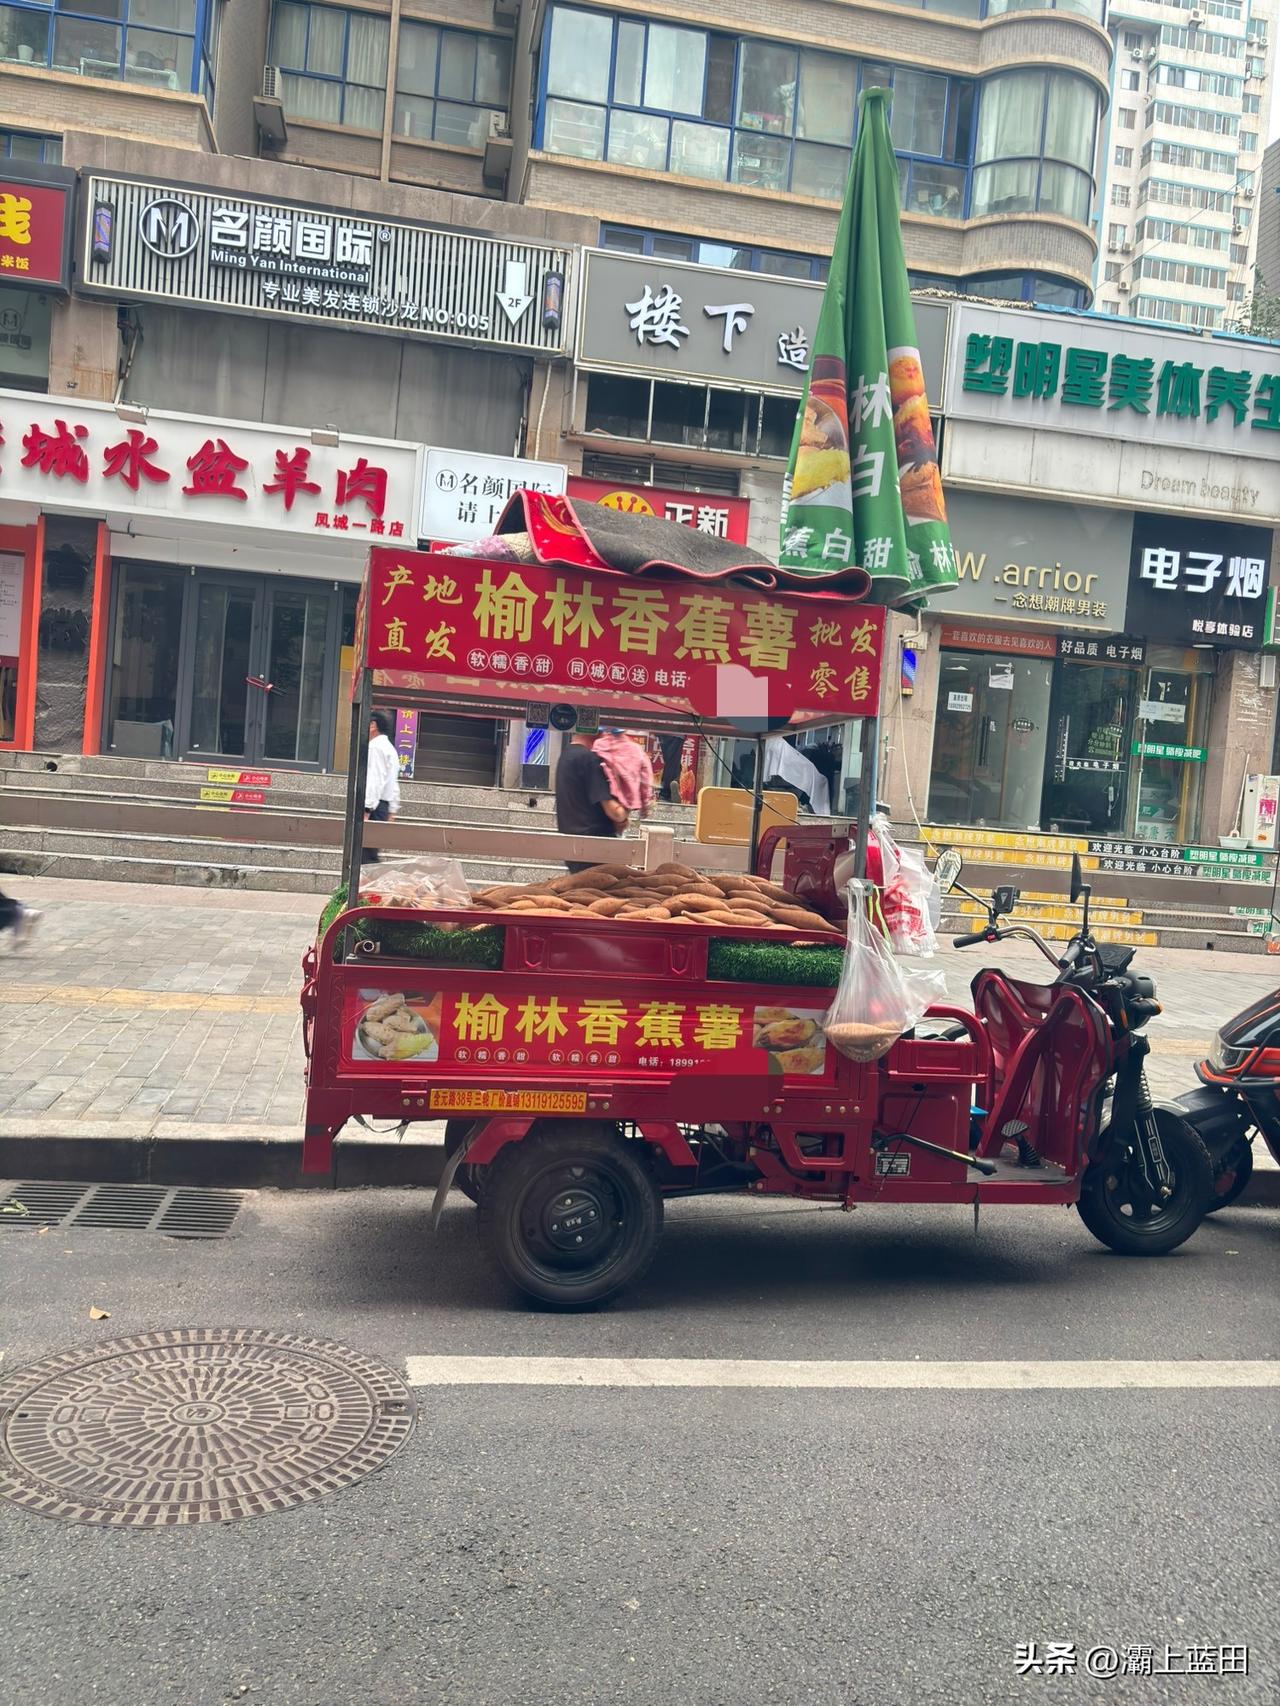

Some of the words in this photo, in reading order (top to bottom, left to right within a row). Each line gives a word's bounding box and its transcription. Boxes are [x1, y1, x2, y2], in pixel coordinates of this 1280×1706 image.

[211, 208, 373, 265] 名颜国际
[1, 255, 30, 270] 米饭
[211, 250, 247, 267] Ming
[251, 256, 276, 270] Yan
[280, 261, 369, 283] International
[508, 297, 521, 309] 2F
[0, 420, 390, 519] 城水盆羊肉
[1141, 470, 1197, 497] Dream
[1200, 478, 1260, 508] beauty
[314, 511, 404, 537] 凤城一路店
[382, 564, 463, 605] 产地
[1140, 547, 1266, 599] 电子烟
[378, 616, 457, 662] 直发
[473, 569, 798, 671] 榆林香蕉薯
[809, 617, 878, 657] 批发
[468, 649, 552, 676] 软糯香甜
[568, 662, 648, 686] 同城配送
[1061, 640, 1098, 657] 好品质
[1106, 644, 1143, 662] 电子烟
[808, 661, 872, 702] 零售
[1092, 842, 1134, 855] 欢迎光临
[1139, 847, 1181, 859] 小心台阶
[1104, 860, 1146, 872] 欢迎光临
[1152, 864, 1193, 876] 小心台阶
[453, 993, 743, 1049] 榆林香蕉薯
[455, 1047, 529, 1064] 软糯香甜
[548, 1048, 621, 1066] 软糯香甜
